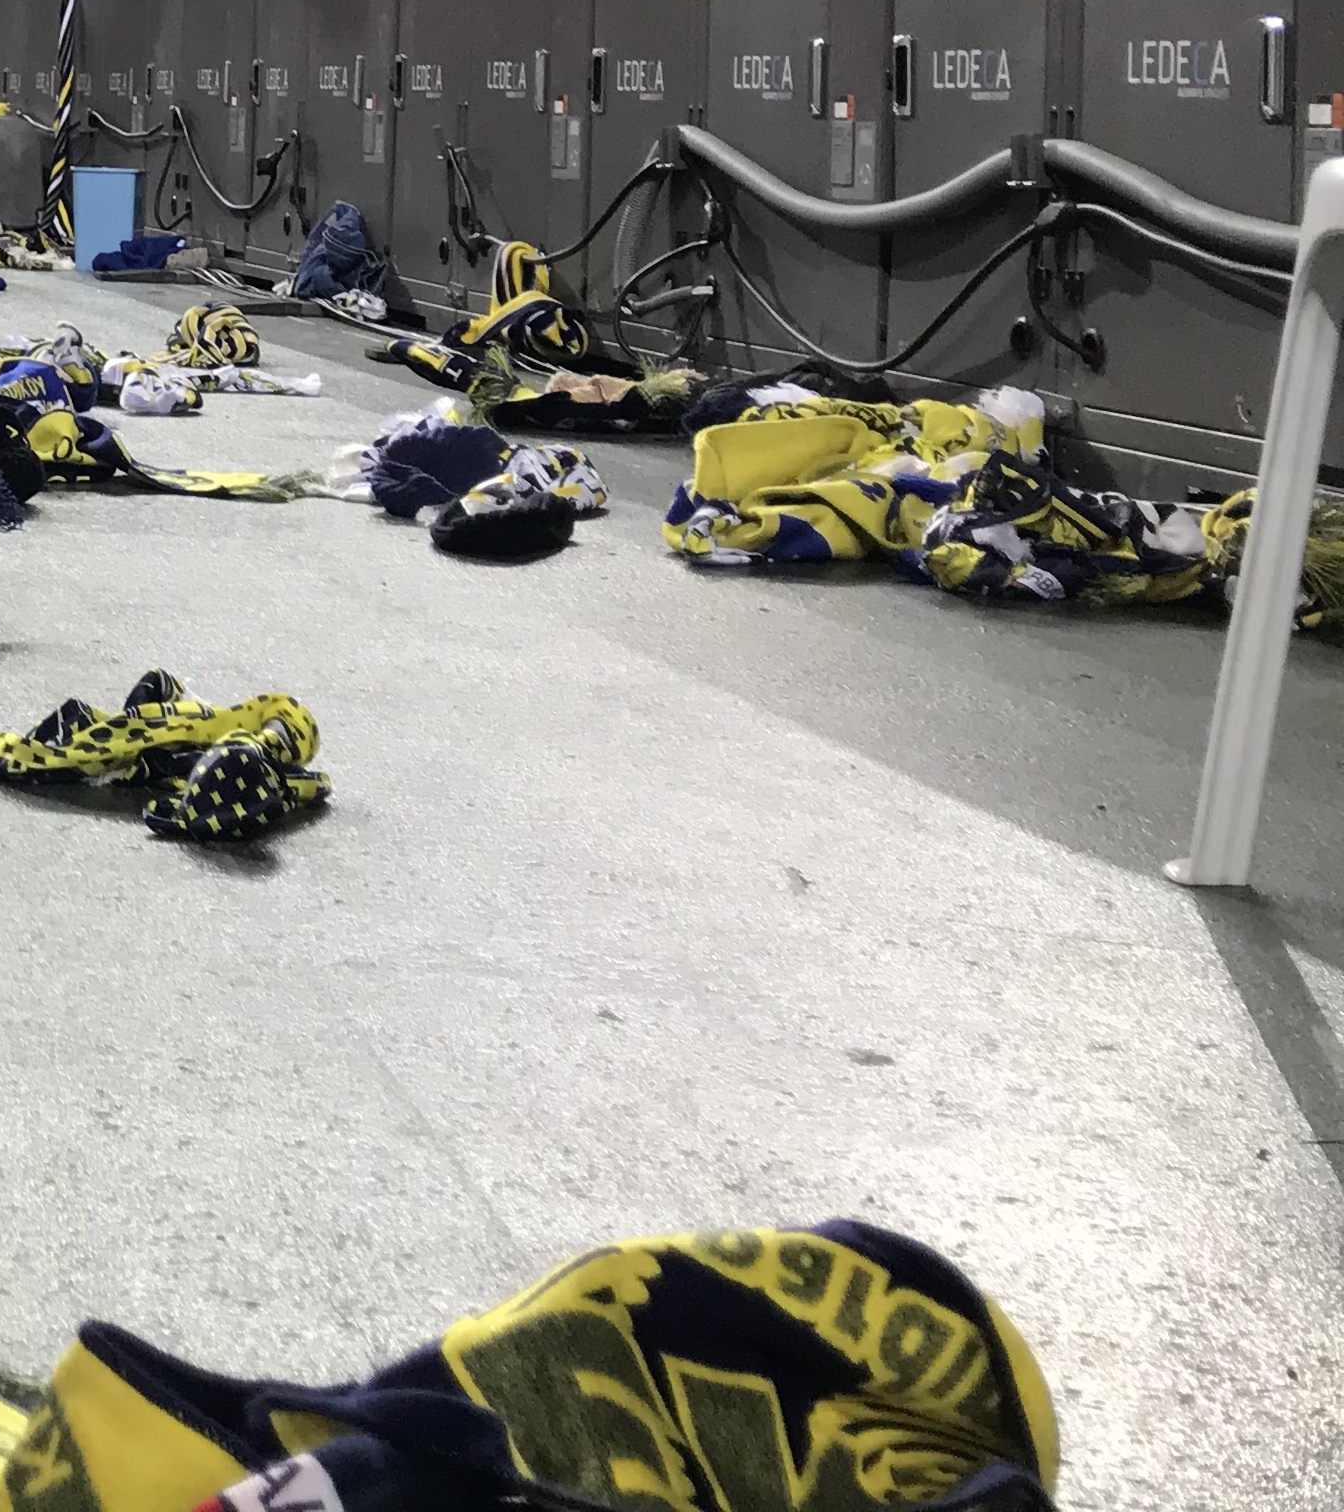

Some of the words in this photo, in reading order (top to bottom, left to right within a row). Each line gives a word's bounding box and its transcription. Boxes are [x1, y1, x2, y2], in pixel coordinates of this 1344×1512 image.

[617, 60, 664, 92] LEDECA
[734, 55, 793, 90] LEDECA
[933, 48, 1012, 89] LEDECA
[1128, 39, 1230, 85] LEDECA
